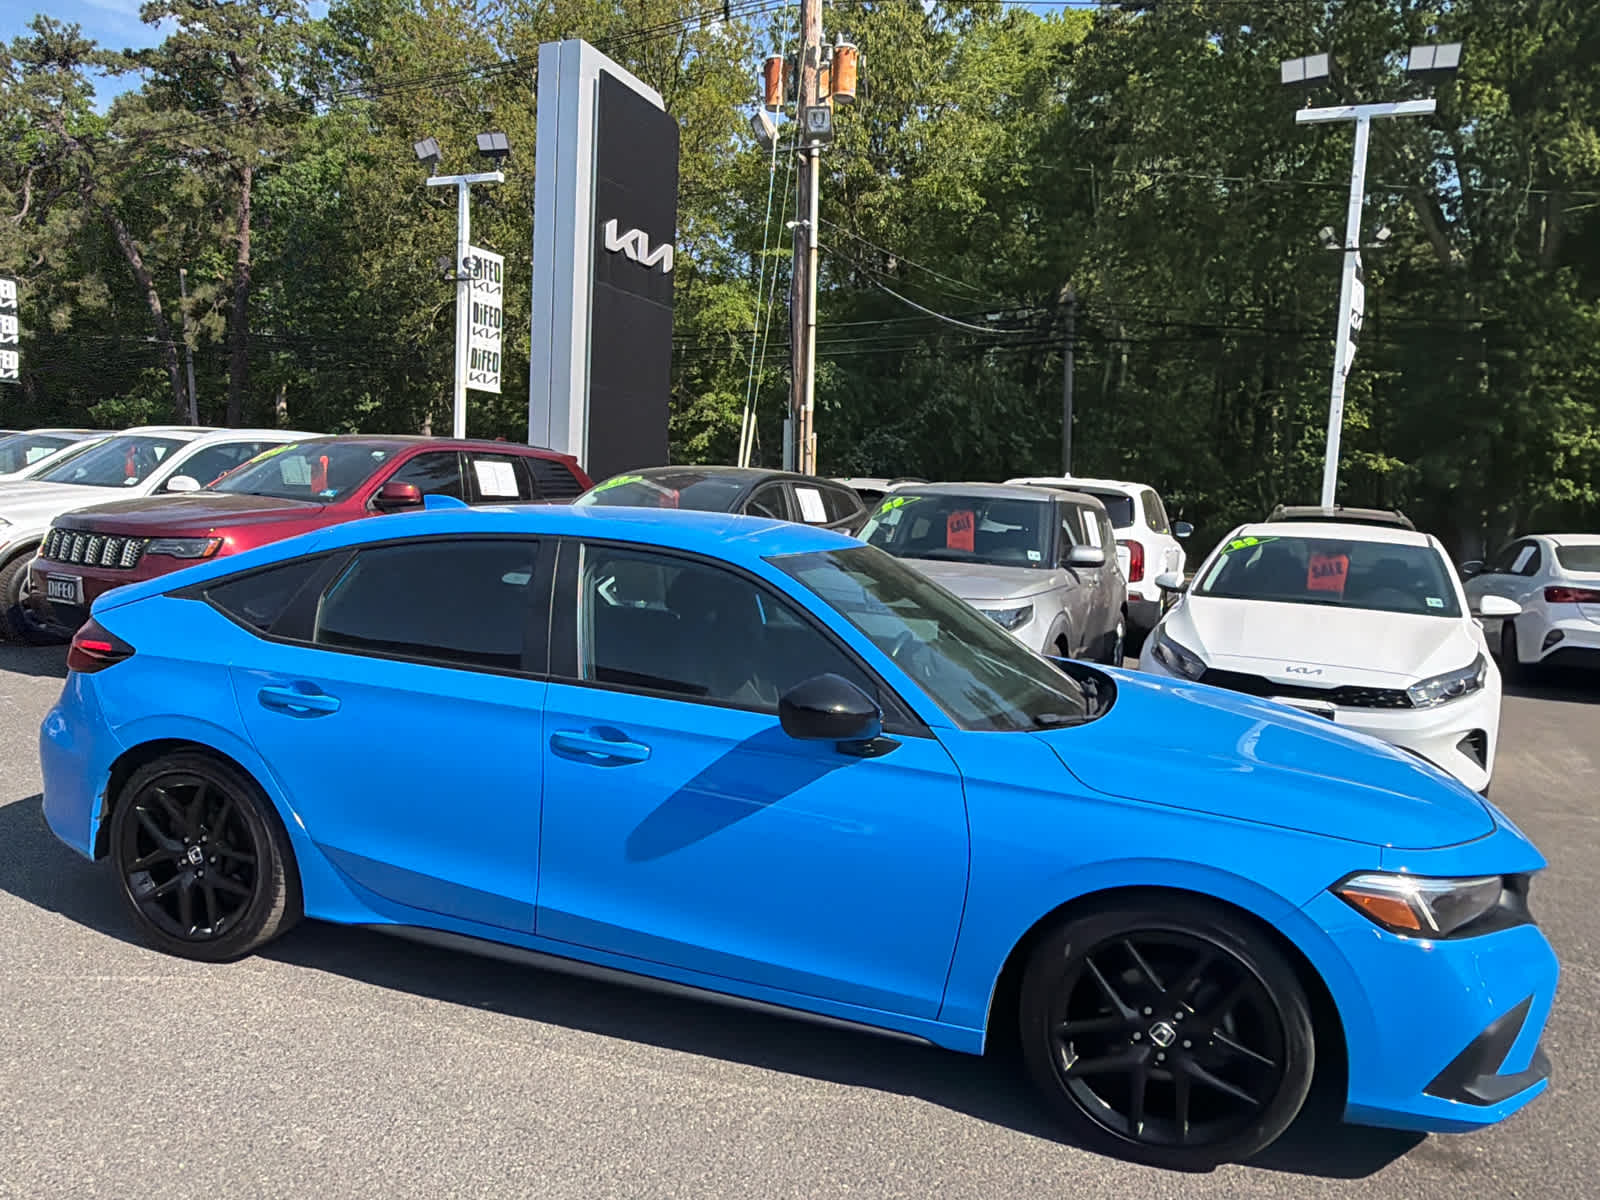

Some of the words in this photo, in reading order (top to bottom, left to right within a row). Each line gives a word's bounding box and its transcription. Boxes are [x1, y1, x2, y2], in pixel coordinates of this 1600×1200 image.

[605, 218, 673, 274] KIA
[472, 302, 501, 329] DiFEO
[472, 326, 500, 341] KIA
[470, 347, 500, 374] DiFEO
[469, 372, 499, 385] KIA
[1286, 666, 1323, 675] KIA
